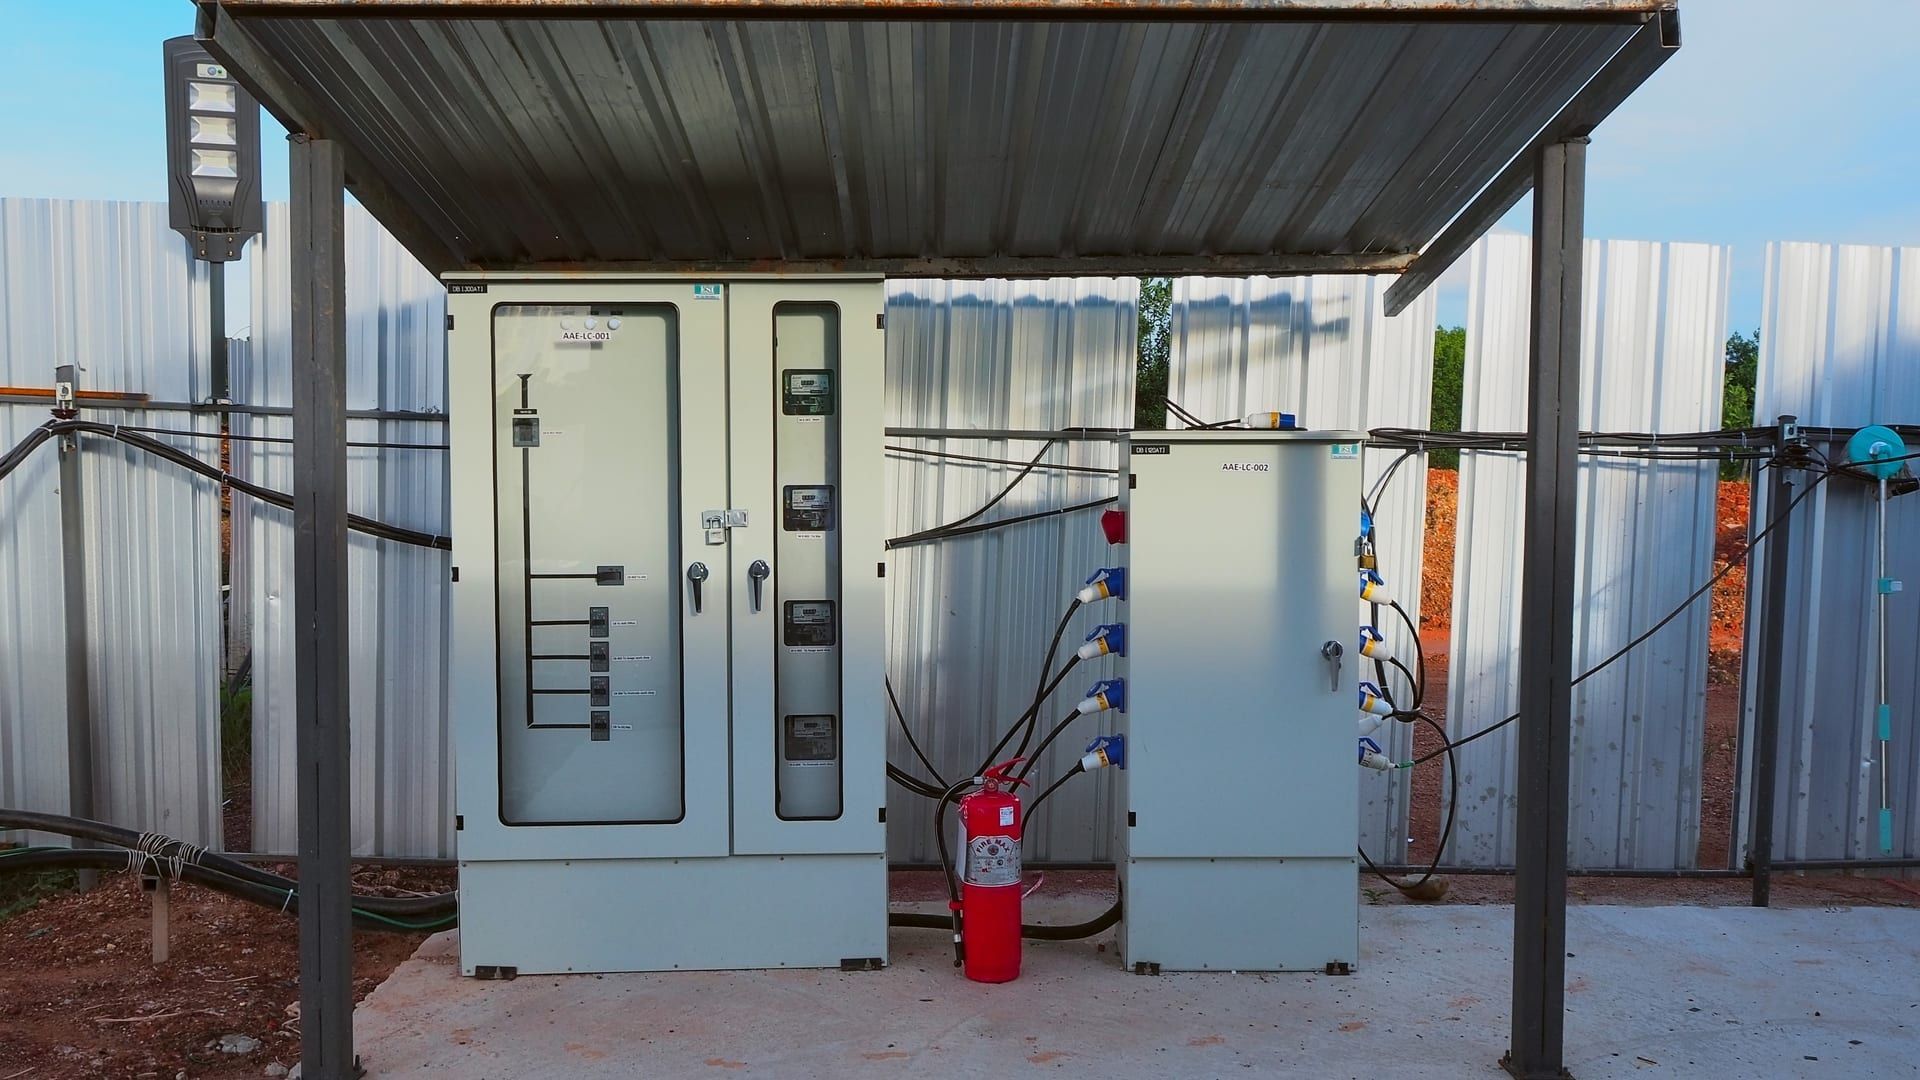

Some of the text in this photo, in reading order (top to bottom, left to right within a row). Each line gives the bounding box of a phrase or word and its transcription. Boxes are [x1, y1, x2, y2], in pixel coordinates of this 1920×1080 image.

[563, 332, 610, 340] AAE-LC-001
[1222, 463, 1269, 471] AAE-LC-002
[975, 839, 1010, 853] FIRE MAX
